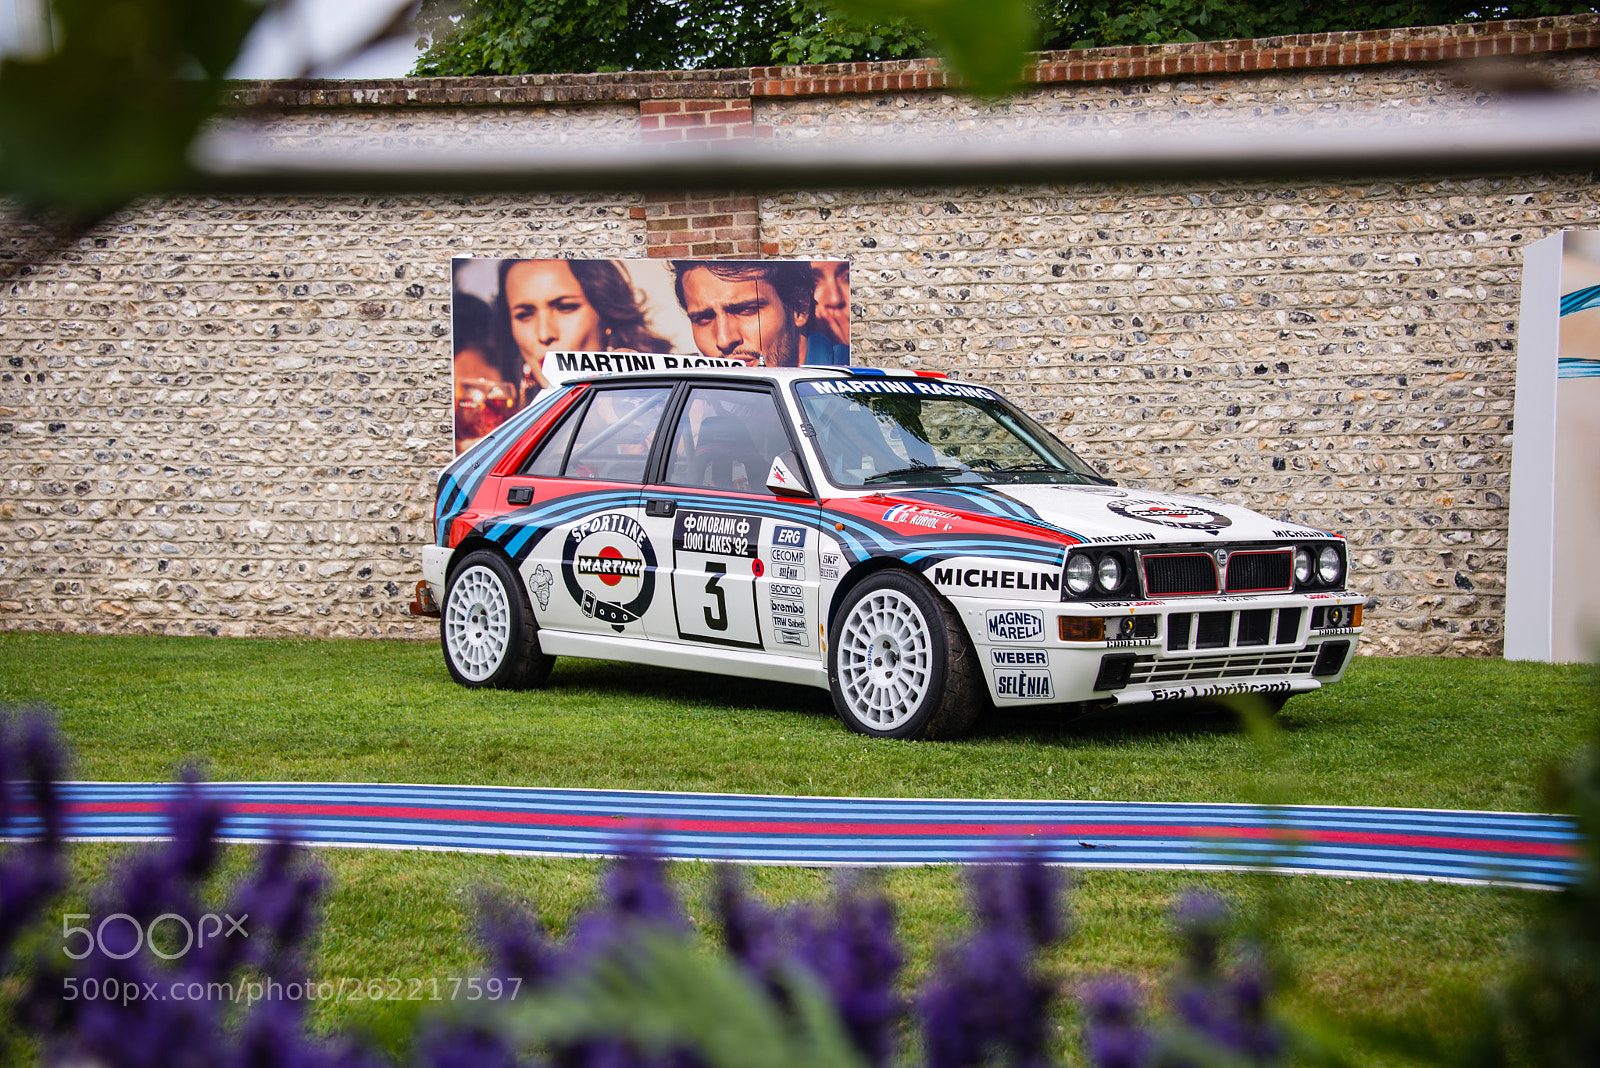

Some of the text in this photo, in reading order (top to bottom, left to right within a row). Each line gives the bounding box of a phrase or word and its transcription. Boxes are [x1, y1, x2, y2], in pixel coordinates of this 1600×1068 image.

[555, 353, 655, 372] MARTINI
[810, 380, 996, 400] MARTINI RACING
[571, 514, 647, 549] SPORTLINE
[696, 515, 737, 535] OKOBANK
[778, 528, 801, 544] ERG
[1092, 532, 1156, 544] MICHELIN
[1271, 529, 1325, 539] MICHELIN
[683, 531, 749, 556] 1000 LAKES '92
[772, 549, 804, 563] CECOMP
[822, 554, 839, 566] SKF
[580, 558, 640, 575] MARTINI
[934, 568, 1060, 591] MICHELIN
[703, 560, 728, 632] 3
[771, 600, 804, 614] brembo
[989, 612, 1042, 630] MAGNETI
[989, 620, 1042, 640] MARELLI
[993, 651, 1046, 664] WEBER
[1151, 688, 1187, 701] Fiat
